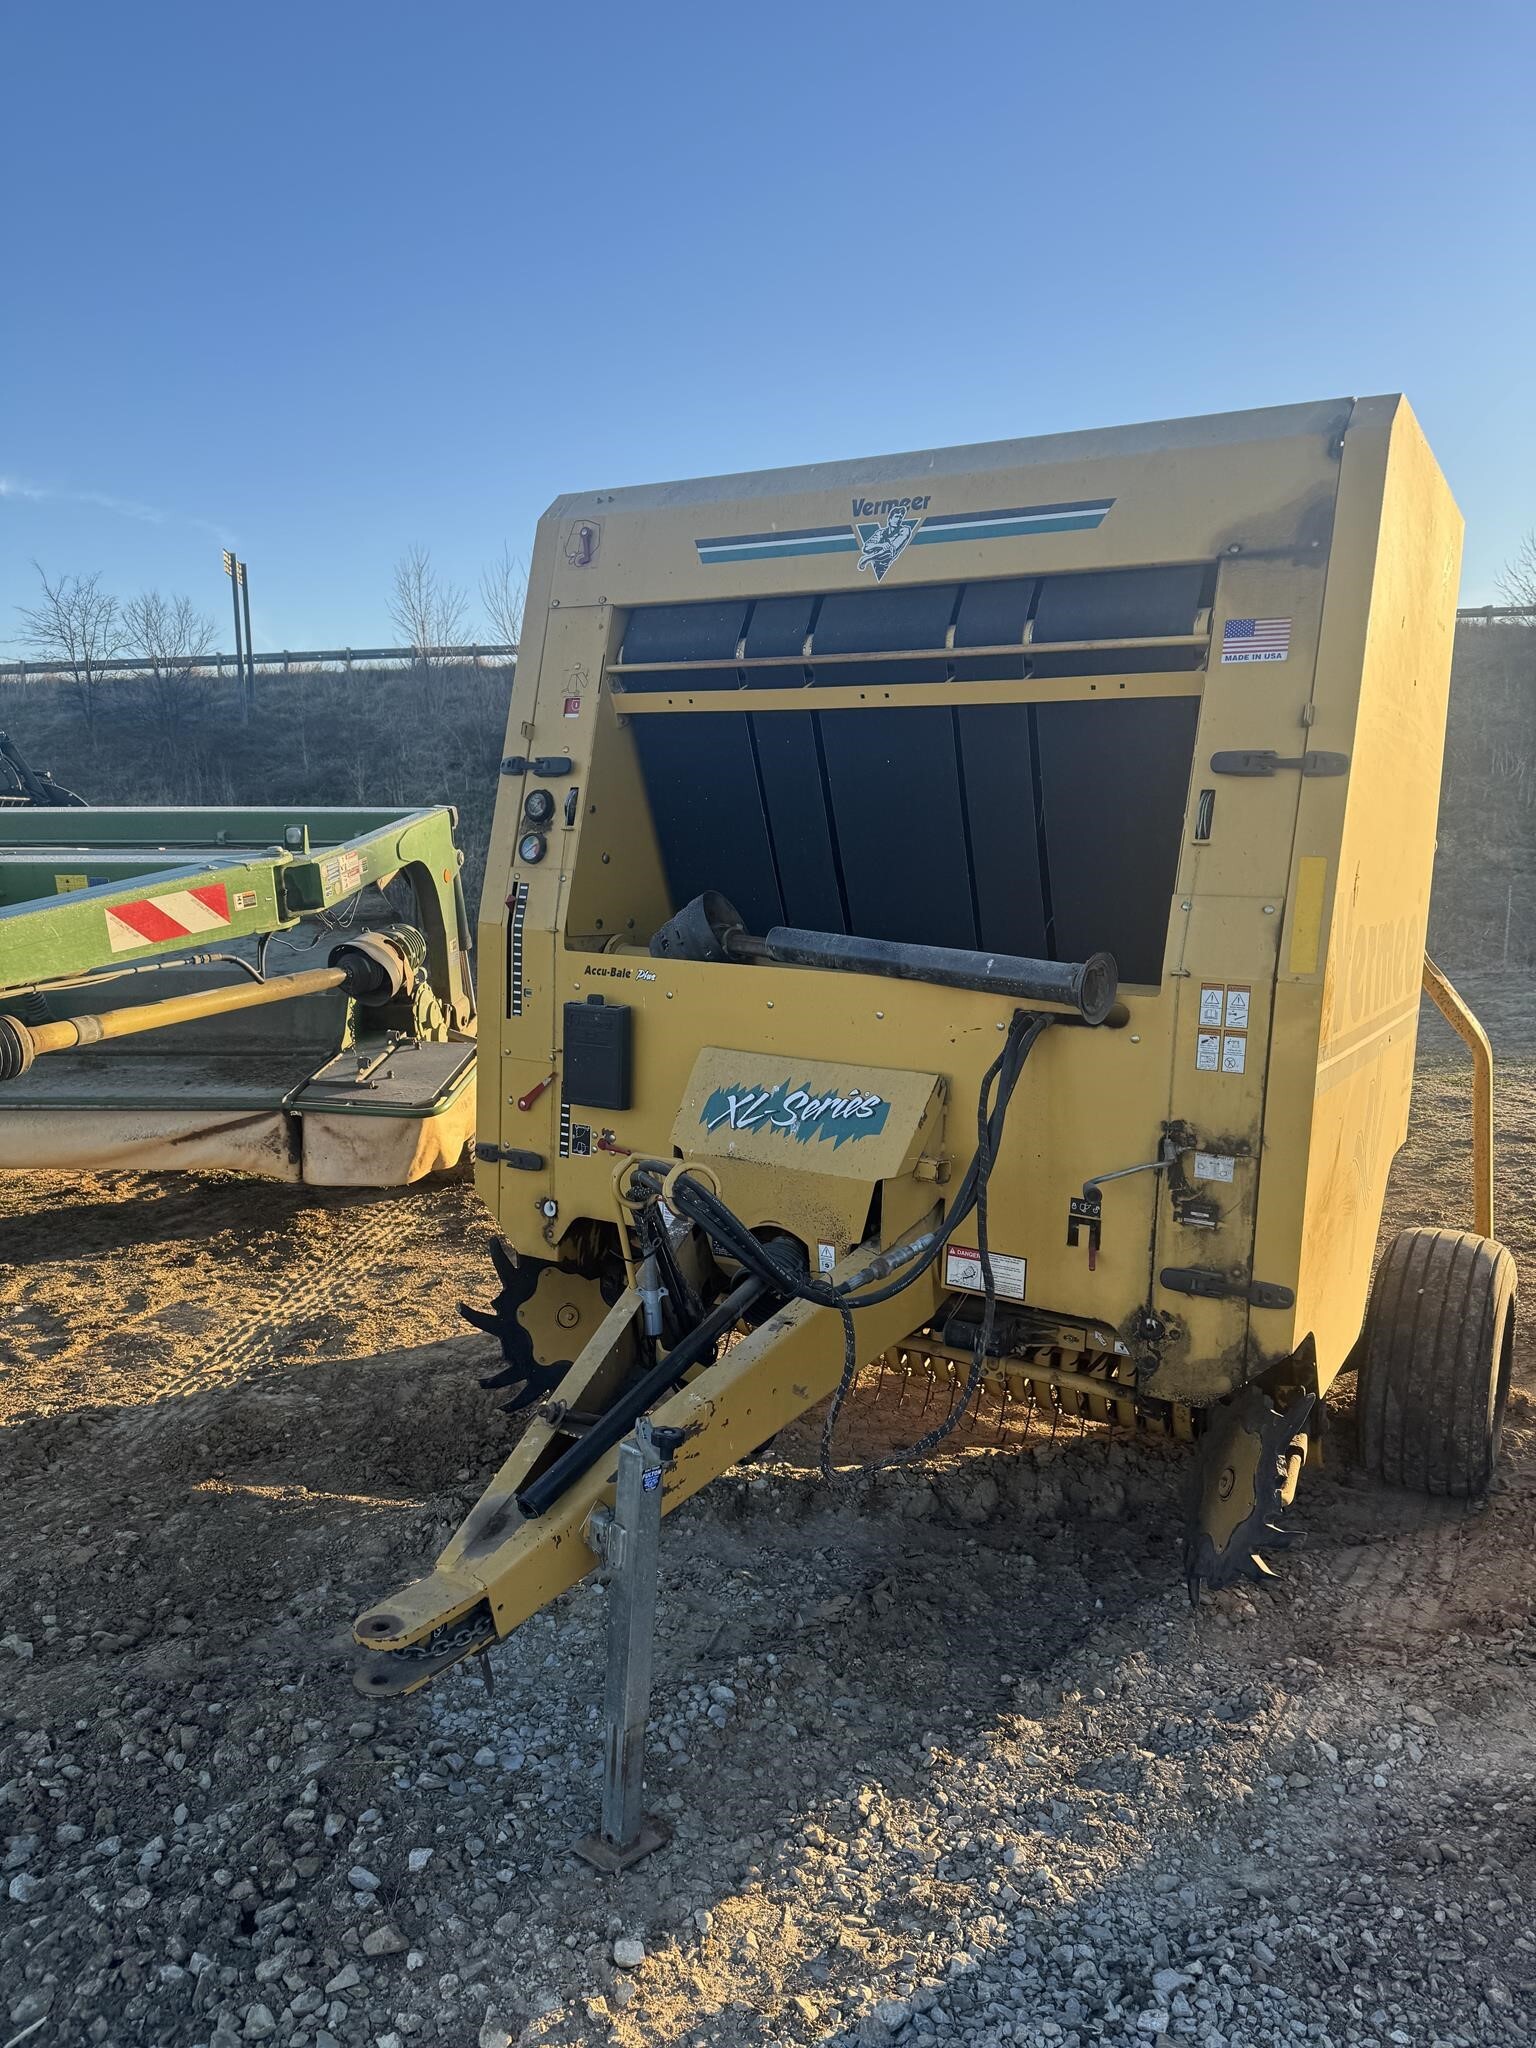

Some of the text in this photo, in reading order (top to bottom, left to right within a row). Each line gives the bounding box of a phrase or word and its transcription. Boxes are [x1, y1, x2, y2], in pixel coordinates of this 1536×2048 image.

[852, 495, 931, 517] Vermeer
[1264, 652, 1282, 660] USA
[584, 965, 656, 981] Accu-Bale Plus
